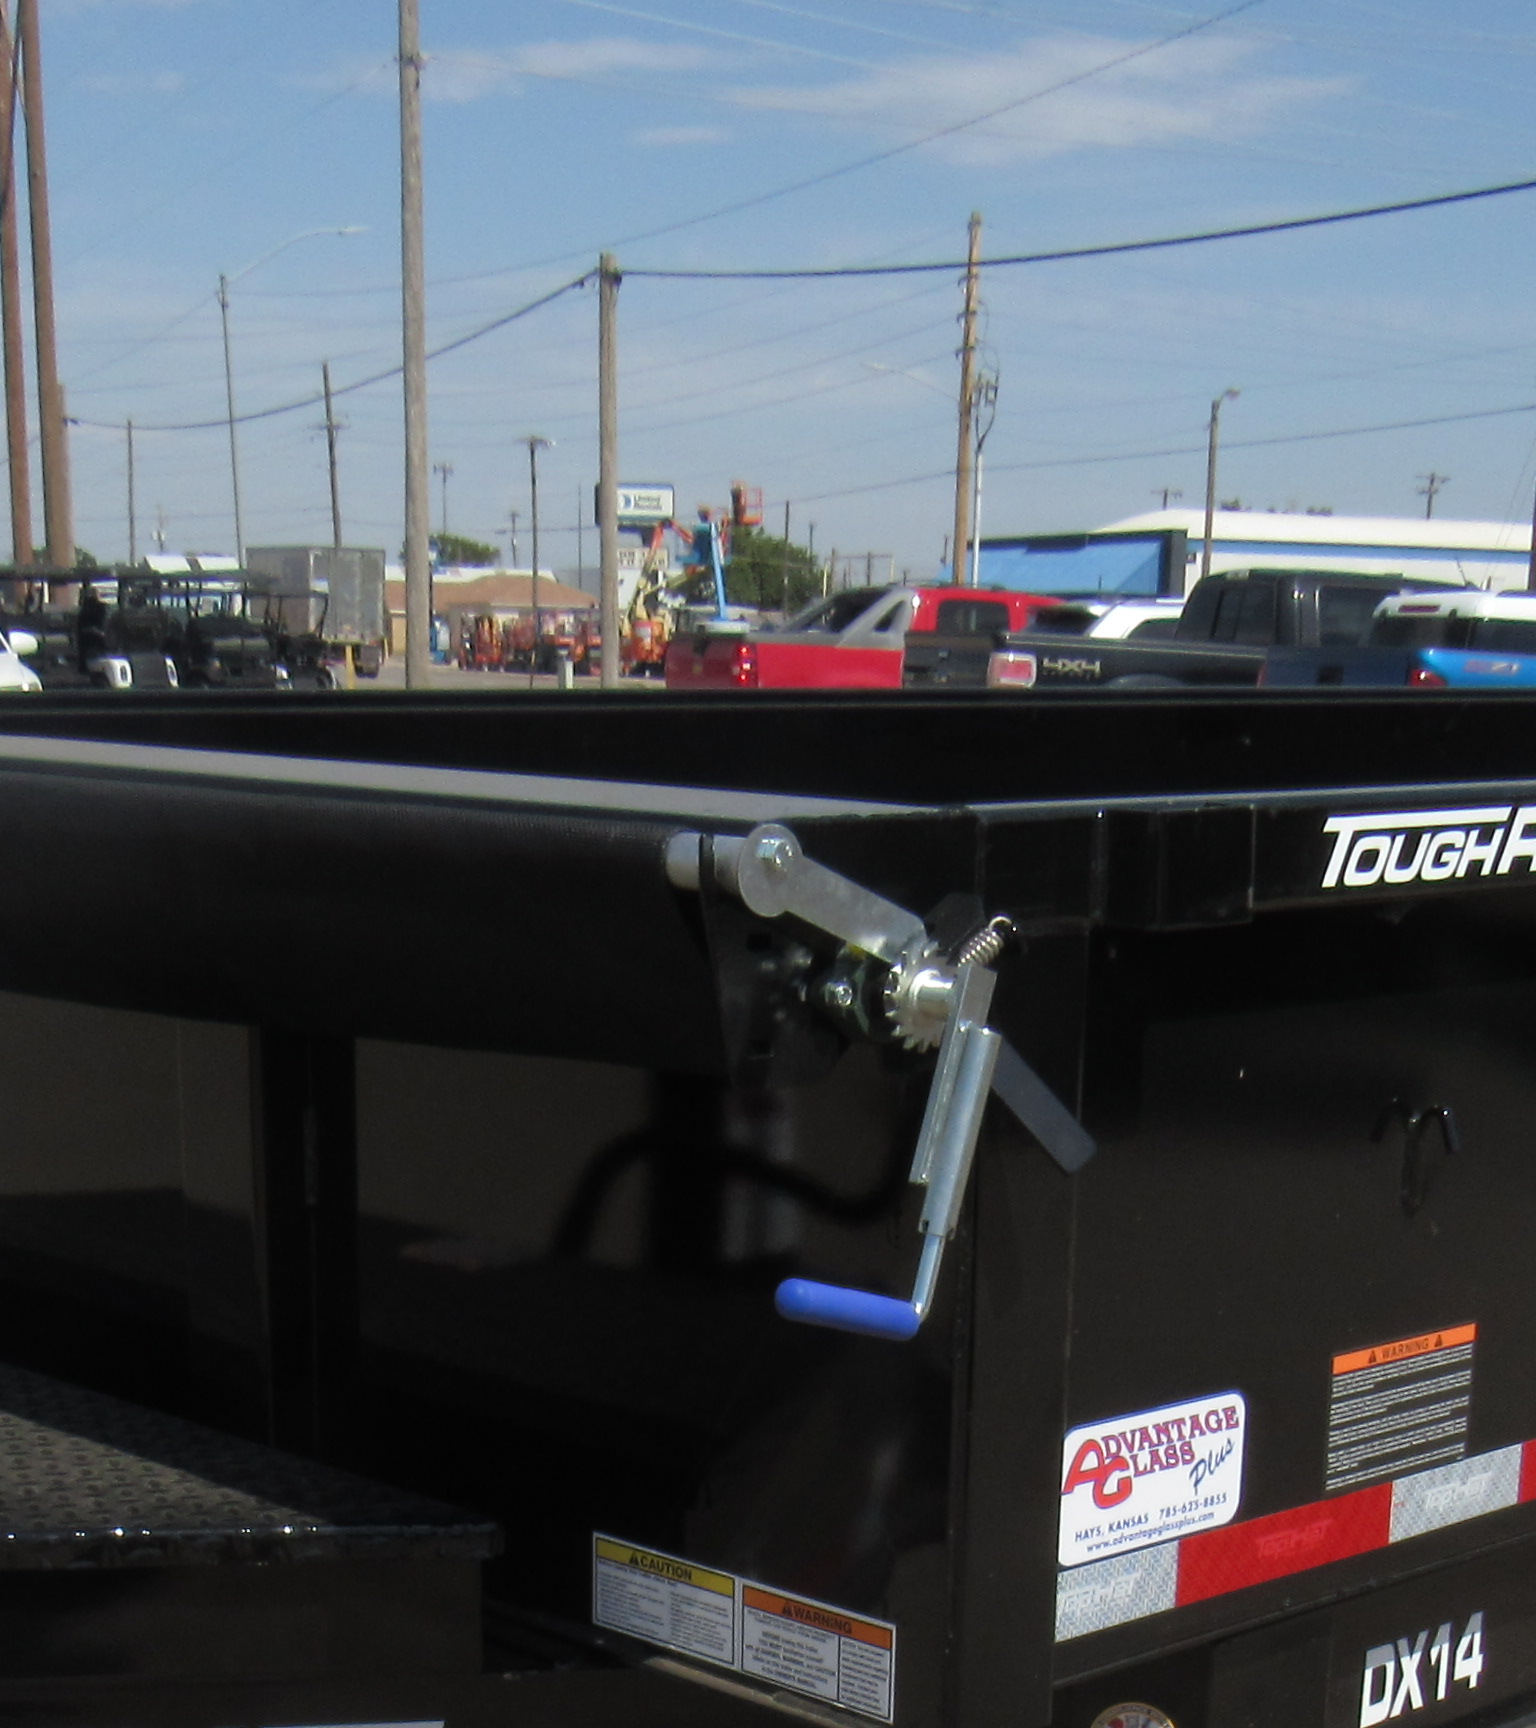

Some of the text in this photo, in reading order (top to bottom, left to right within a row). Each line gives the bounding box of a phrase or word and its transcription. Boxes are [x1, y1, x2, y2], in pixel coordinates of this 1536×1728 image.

[1380, 1337, 1430, 1359] WARNING
[1061, 1405, 1240, 1496] ADVANTAGE
[1189, 1437, 1235, 1496] Plus
[1093, 1441, 1196, 1509] GLASS
[1074, 1528, 1106, 1543] HAYS,
[1108, 1513, 1150, 1534] KANSAS
[1086, 1511, 1216, 1553] www.advantageglassplus.com
[639, 1554, 693, 1581] CAUTION
[793, 1605, 853, 1635] WARNING
